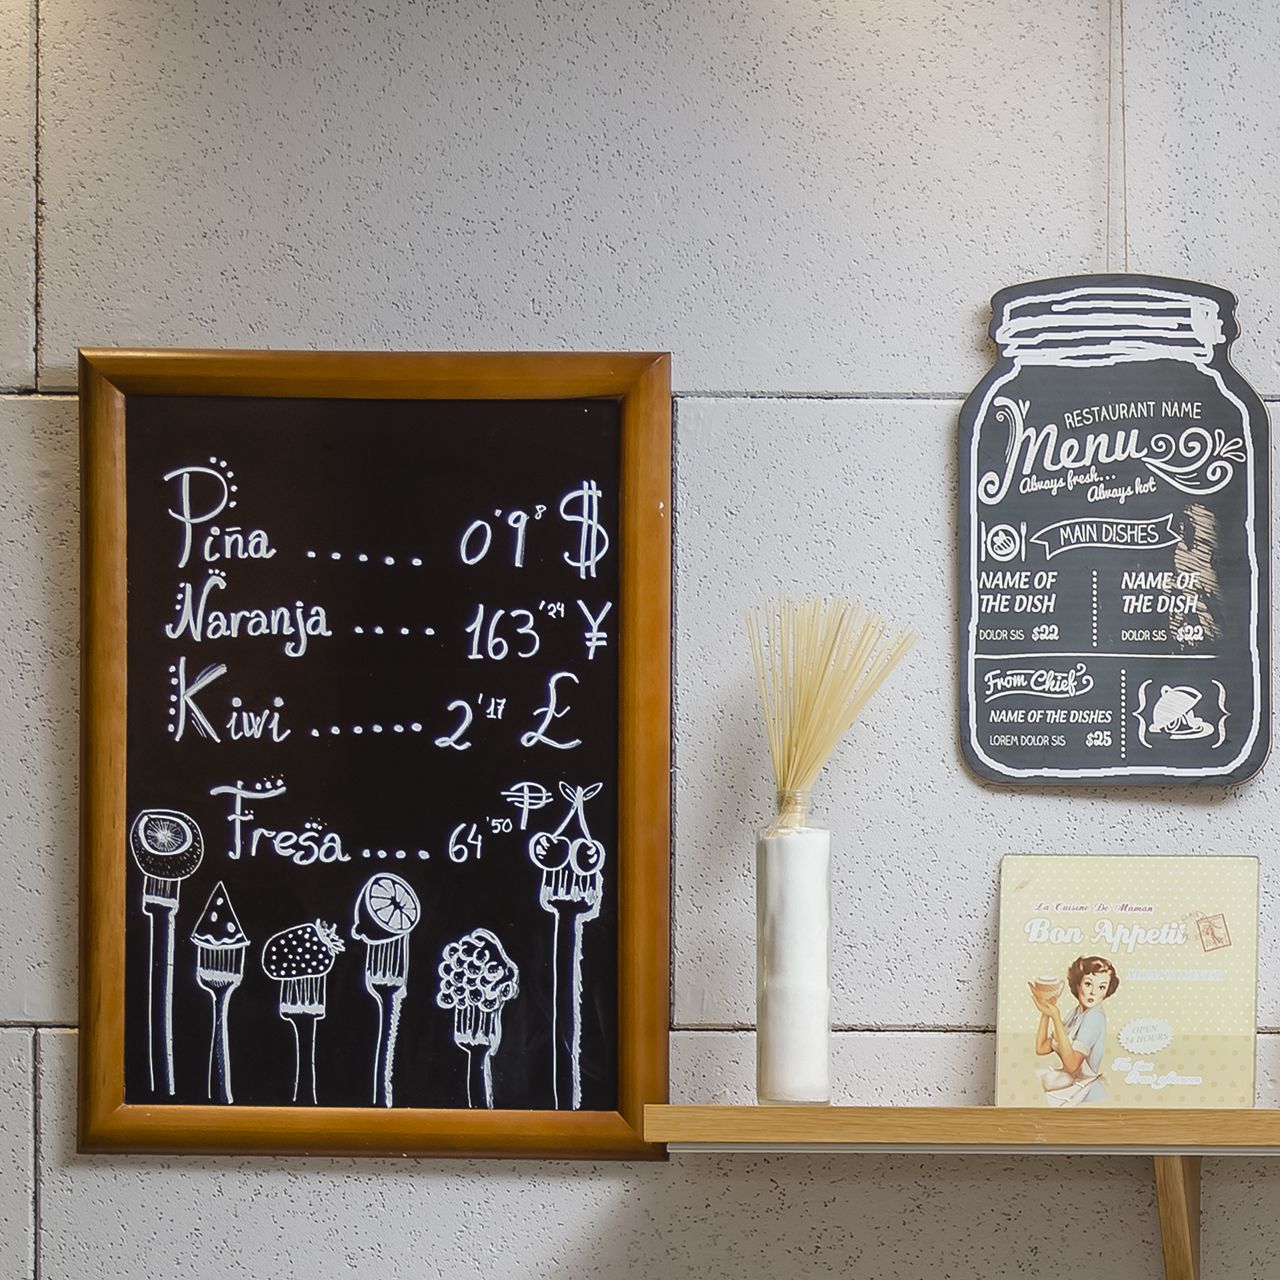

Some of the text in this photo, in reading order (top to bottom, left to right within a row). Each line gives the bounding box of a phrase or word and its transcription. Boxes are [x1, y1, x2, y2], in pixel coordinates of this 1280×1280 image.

[1064, 402, 1202, 429] RESTAURANT NAME
[1019, 474, 1065, 495] Always
[1087, 476, 1156, 504] Always hot
[164, 465, 278, 569] Piña
[1060, 524, 1158, 545] MAIN DISHES
[979, 571, 1057, 589] NAME OF
[1121, 571, 1200, 589] NAME OF
[980, 594, 1056, 613] THE DISH
[1122, 595, 1198, 614] THE DISH
[166, 574, 334, 657] Naranja
[979, 625, 1059, 641] DOLOR SIS $22
[1121, 625, 1204, 642] DOLOR SIS $22
[984, 669, 1028, 695] From
[174, 662, 291, 744] Kiwi
[989, 710, 1113, 724] NAME OF THE DISHES
[989, 731, 1112, 747] LOREM DOLOR SIS $25
[210, 782, 352, 865] Fresa
[1023, 916, 1186, 954] Bon Appetit
